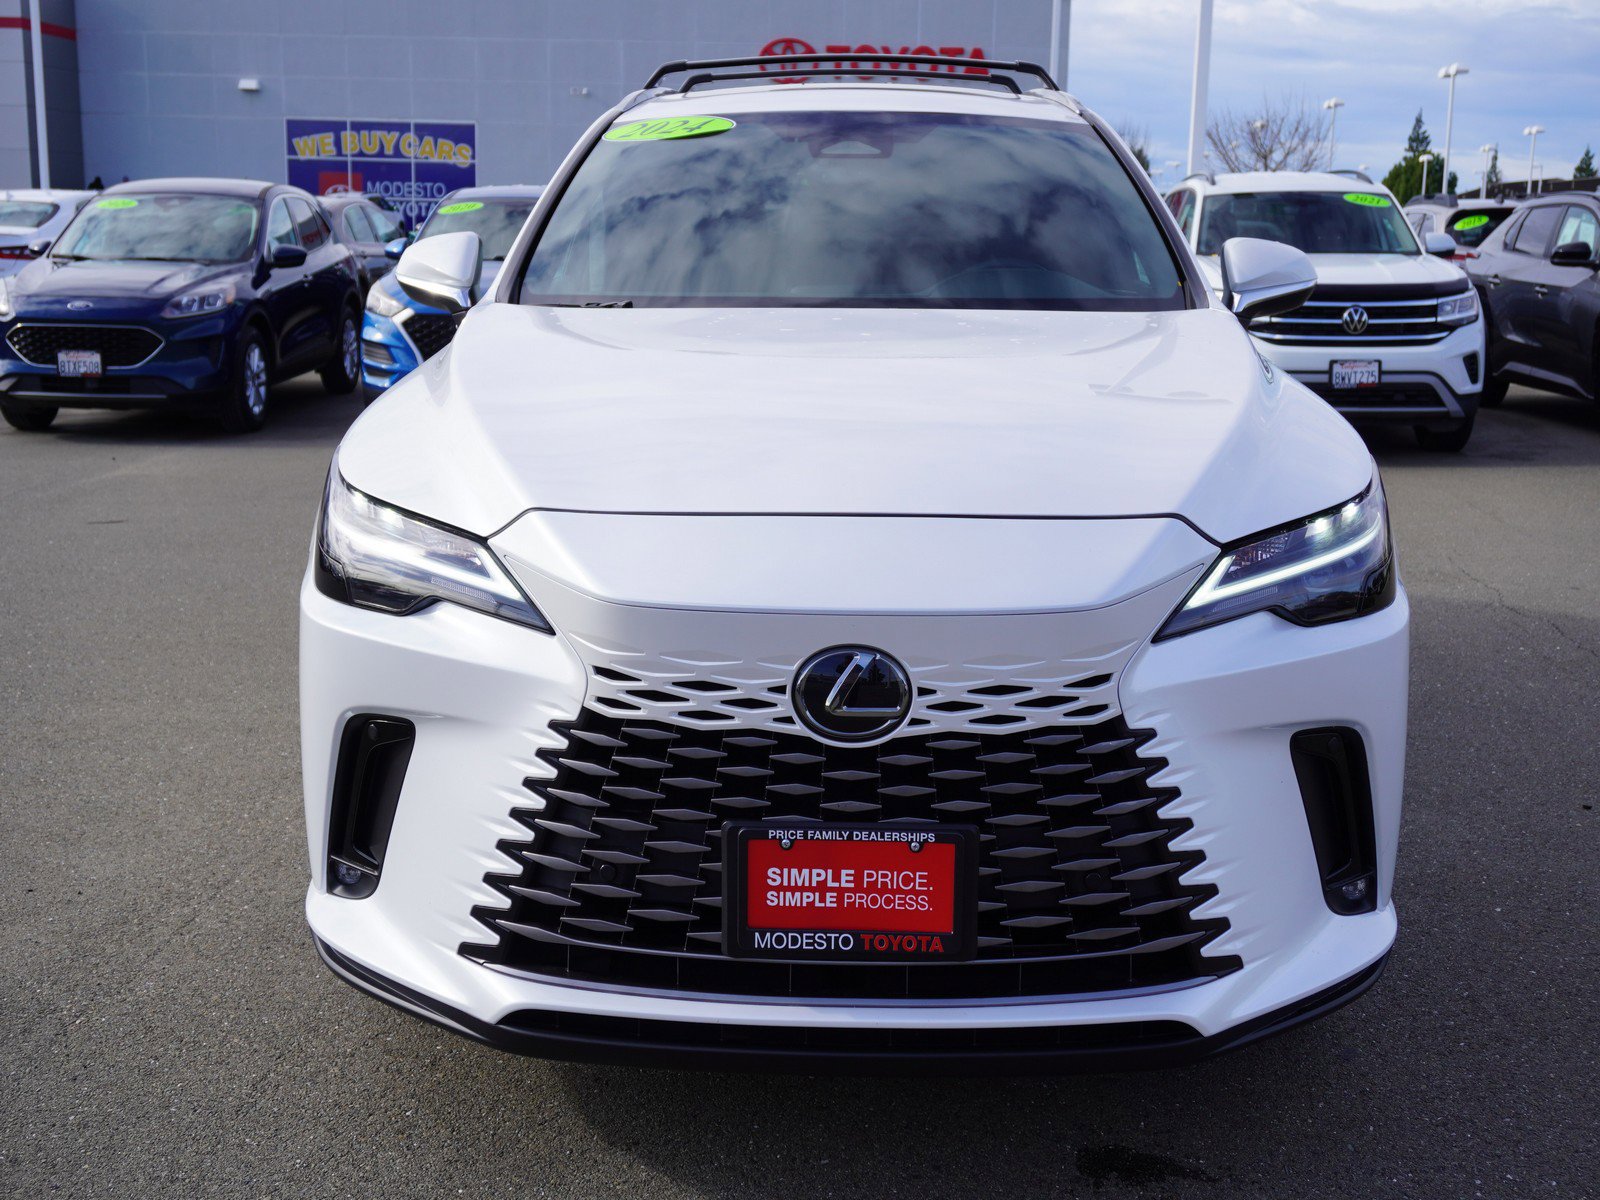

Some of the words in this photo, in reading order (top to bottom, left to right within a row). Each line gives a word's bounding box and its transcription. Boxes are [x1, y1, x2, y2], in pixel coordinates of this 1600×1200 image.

[826, 44, 989, 81] TOYOTA
[617, 118, 716, 138] 2024
[292, 132, 337, 159] WE
[341, 130, 400, 156] BUY
[399, 133, 472, 168] CARS
[366, 180, 447, 198] MODESTO
[768, 830, 804, 840] PRICE
[807, 830, 849, 841] FAMILY
[853, 831, 935, 843] DEALERSHIPS
[766, 867, 855, 888] SIMPLE
[863, 870, 934, 891] PRICE.
[766, 891, 837, 908] SIMPLE
[844, 893, 933, 911] PROCESS.
[754, 932, 854, 950] MODESTO
[860, 933, 944, 953] TOYOTA
